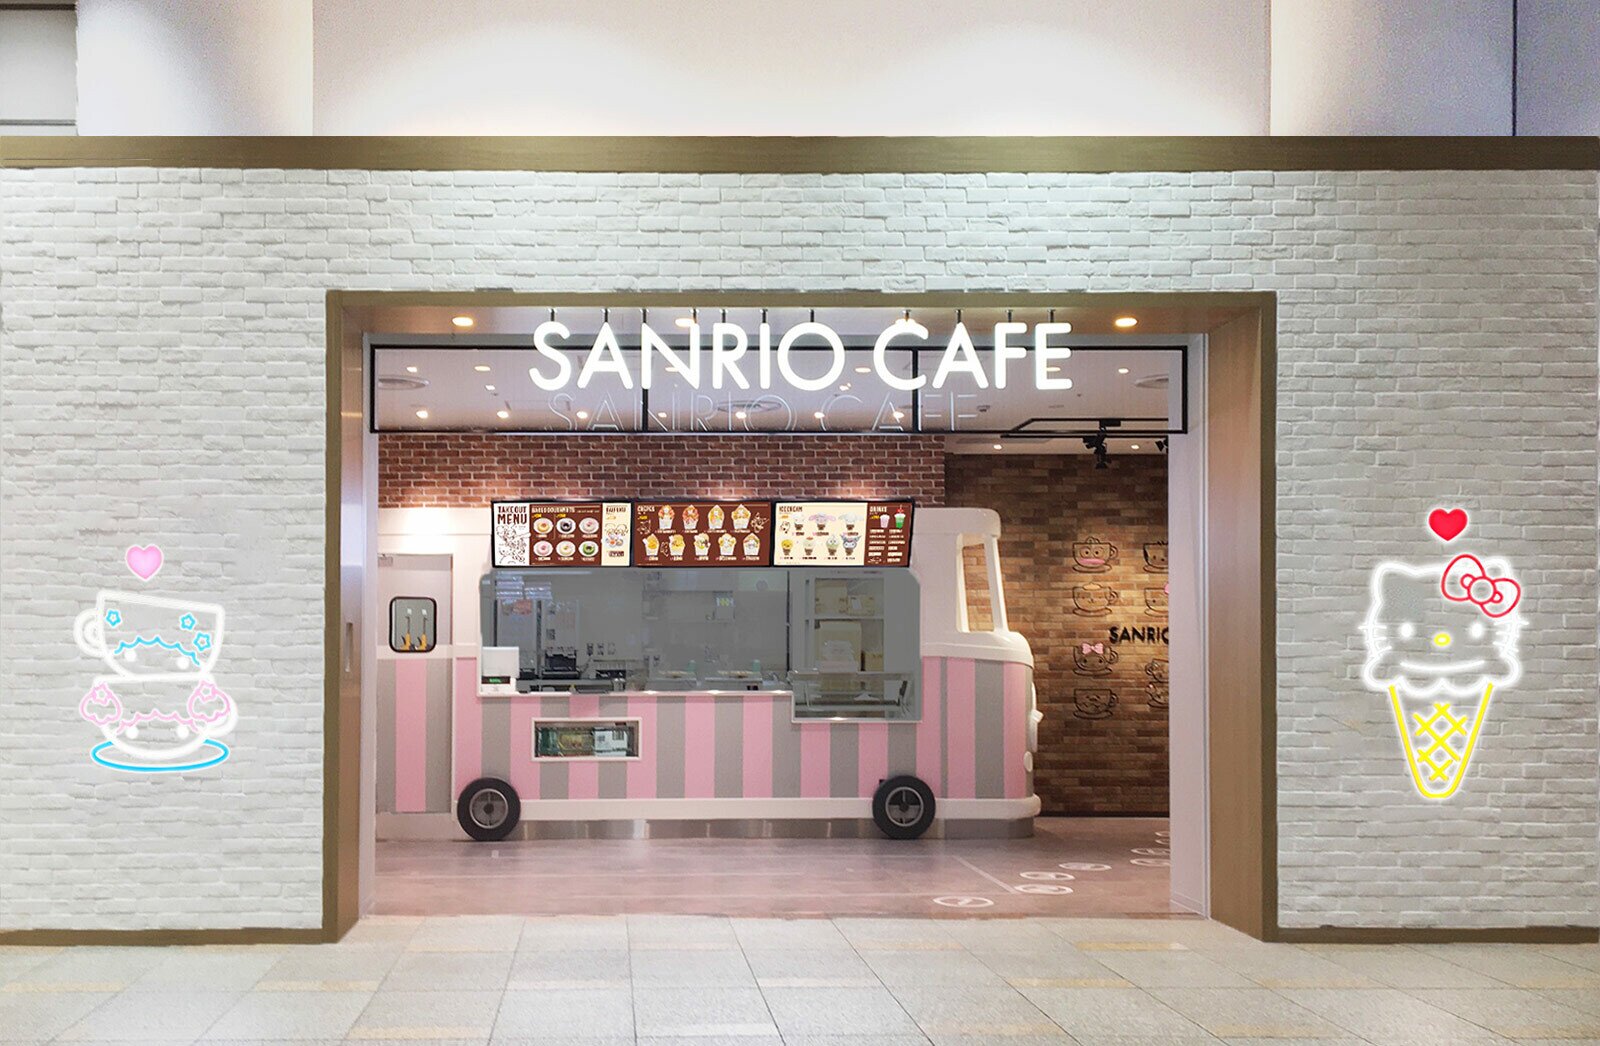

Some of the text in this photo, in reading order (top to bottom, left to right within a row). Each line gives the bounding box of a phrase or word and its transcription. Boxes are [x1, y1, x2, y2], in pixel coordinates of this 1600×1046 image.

[529, 321, 1074, 391] SANRIO CAFE
[497, 513, 528, 526] MENU
